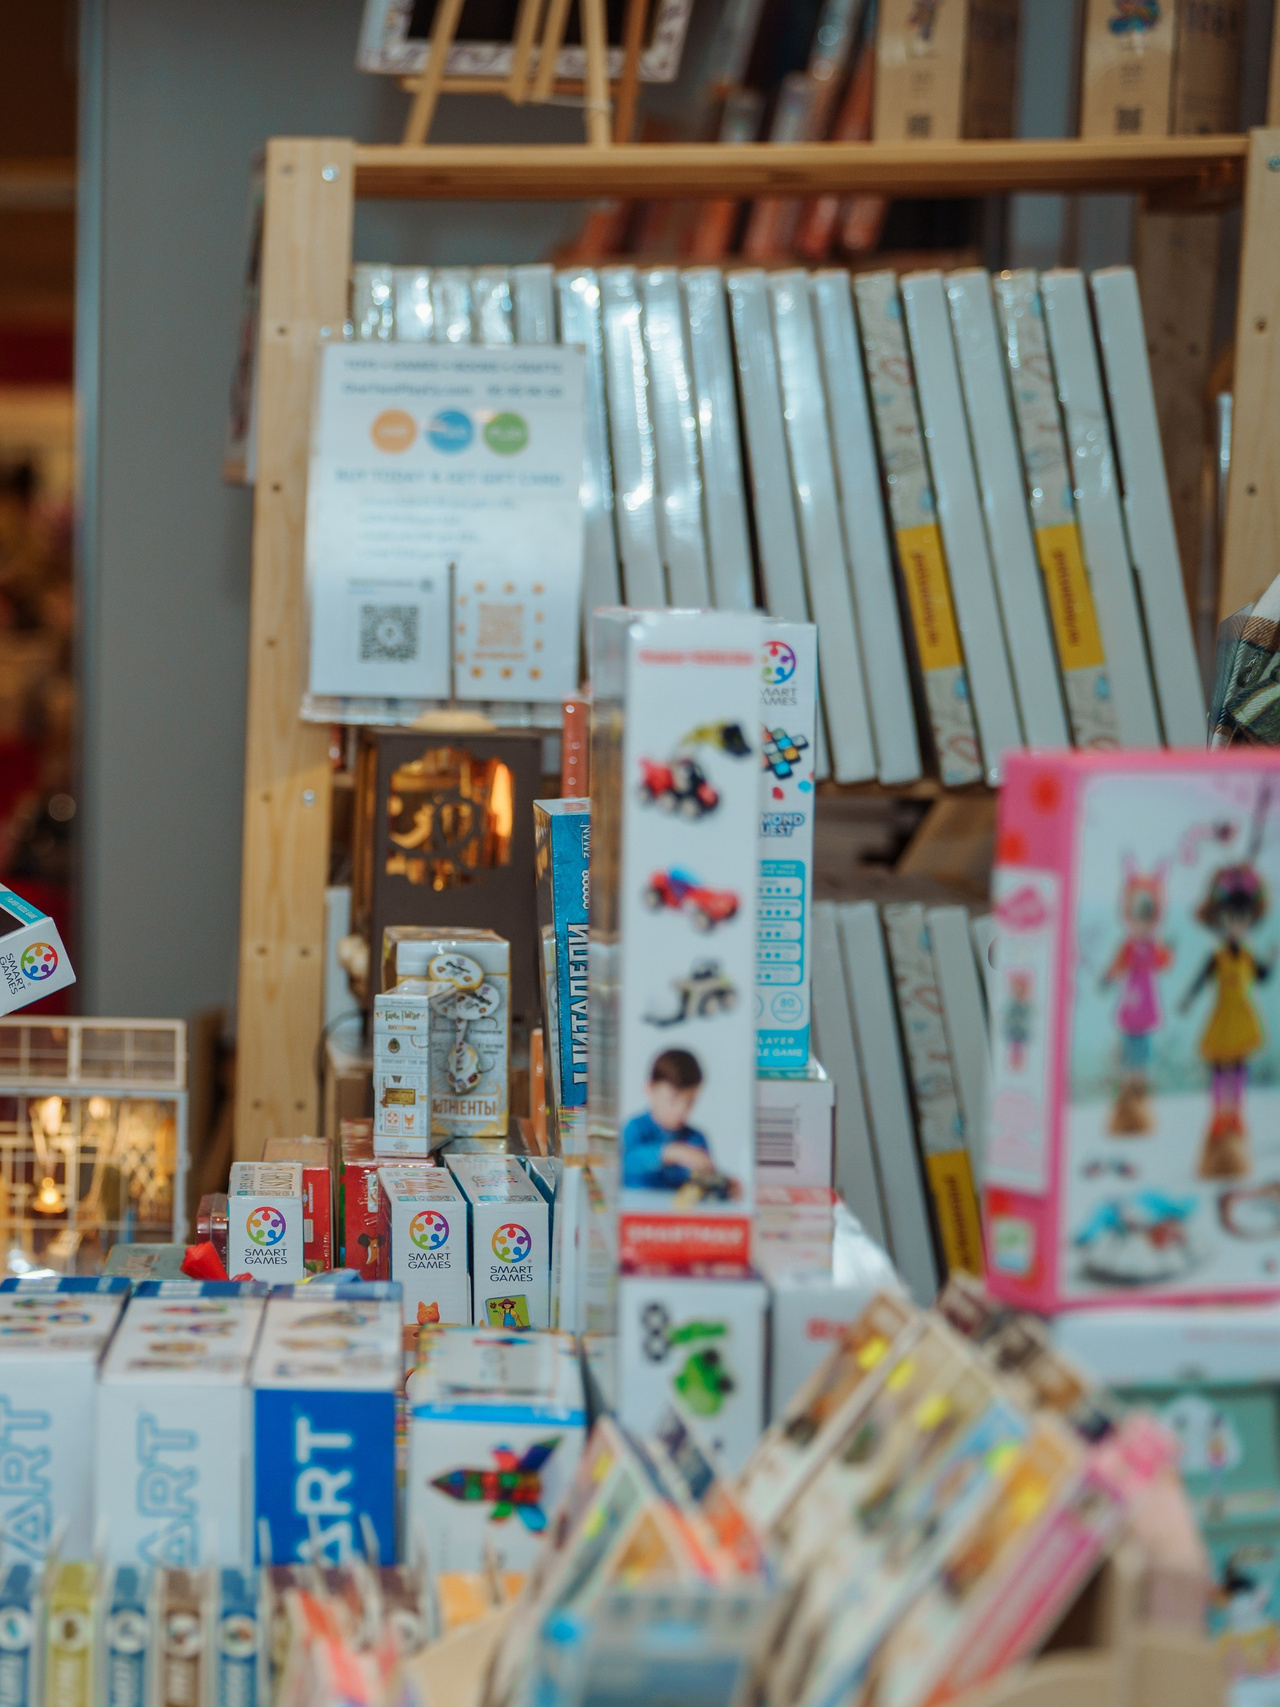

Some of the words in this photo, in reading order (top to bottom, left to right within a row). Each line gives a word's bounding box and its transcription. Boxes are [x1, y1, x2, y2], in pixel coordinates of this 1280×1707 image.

[761, 688, 797, 696] MART
[761, 697, 797, 705] AMES
[761, 812, 805, 827] MOND
[760, 826, 793, 837] UEST
[0, 956, 19, 995] GAMES
[5, 953, 27, 991] SMART
[758, 1037, 795, 1045] LAYER
[245, 1248, 288, 1256] SMART
[244, 1257, 288, 1265] GAMES
[408, 1253, 451, 1261] SMART
[408, 1261, 451, 1269] GAMES
[490, 1266, 533, 1274] SMART
[490, 1274, 533, 1282] GAMES
[136, 1413, 198, 1565] ART
[295, 1416, 354, 1564] ART
